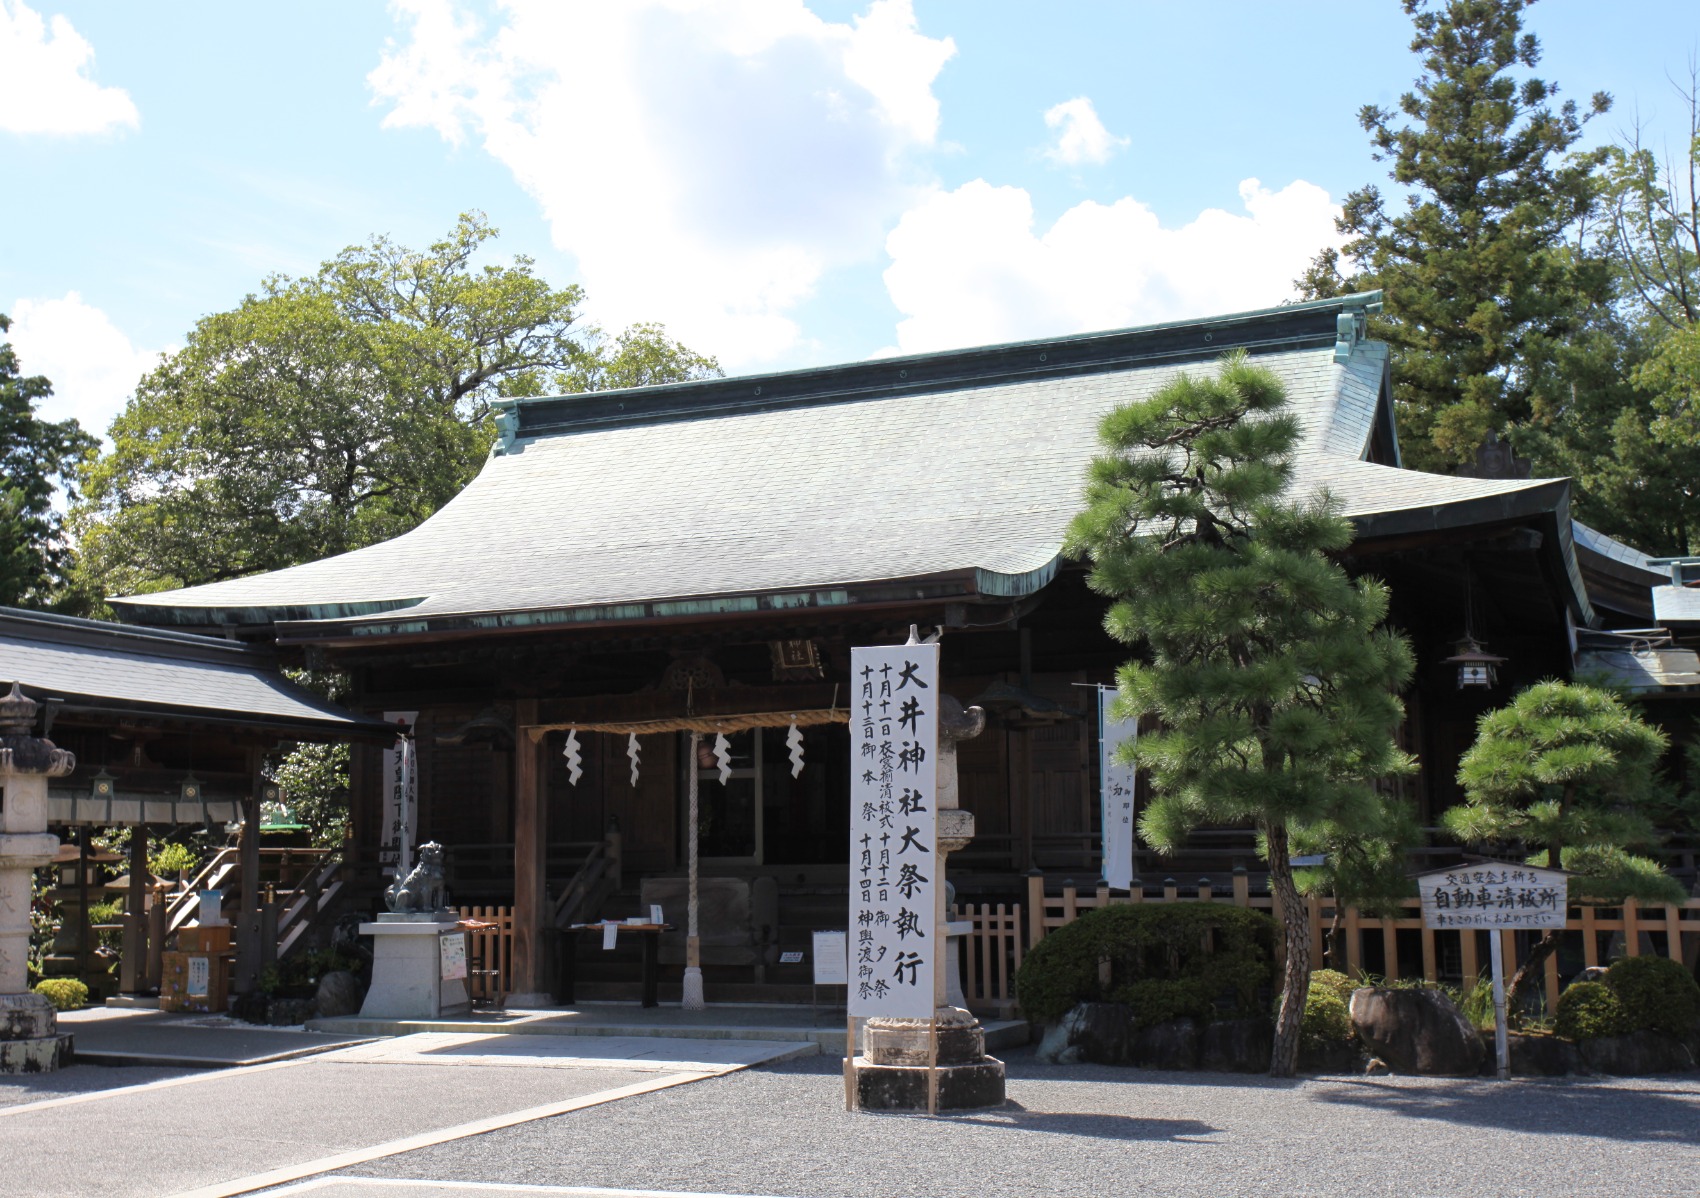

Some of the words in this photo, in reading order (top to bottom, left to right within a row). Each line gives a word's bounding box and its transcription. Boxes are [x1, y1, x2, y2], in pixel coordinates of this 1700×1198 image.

[892, 660, 930, 986] 大井神社大祭執行
[1445, 870, 1538, 886] 交通安全を祈る
[1433, 886, 1559, 911] 自動車清祓所
[1437, 913, 1551, 927] 車をこの前にお止め下さい
